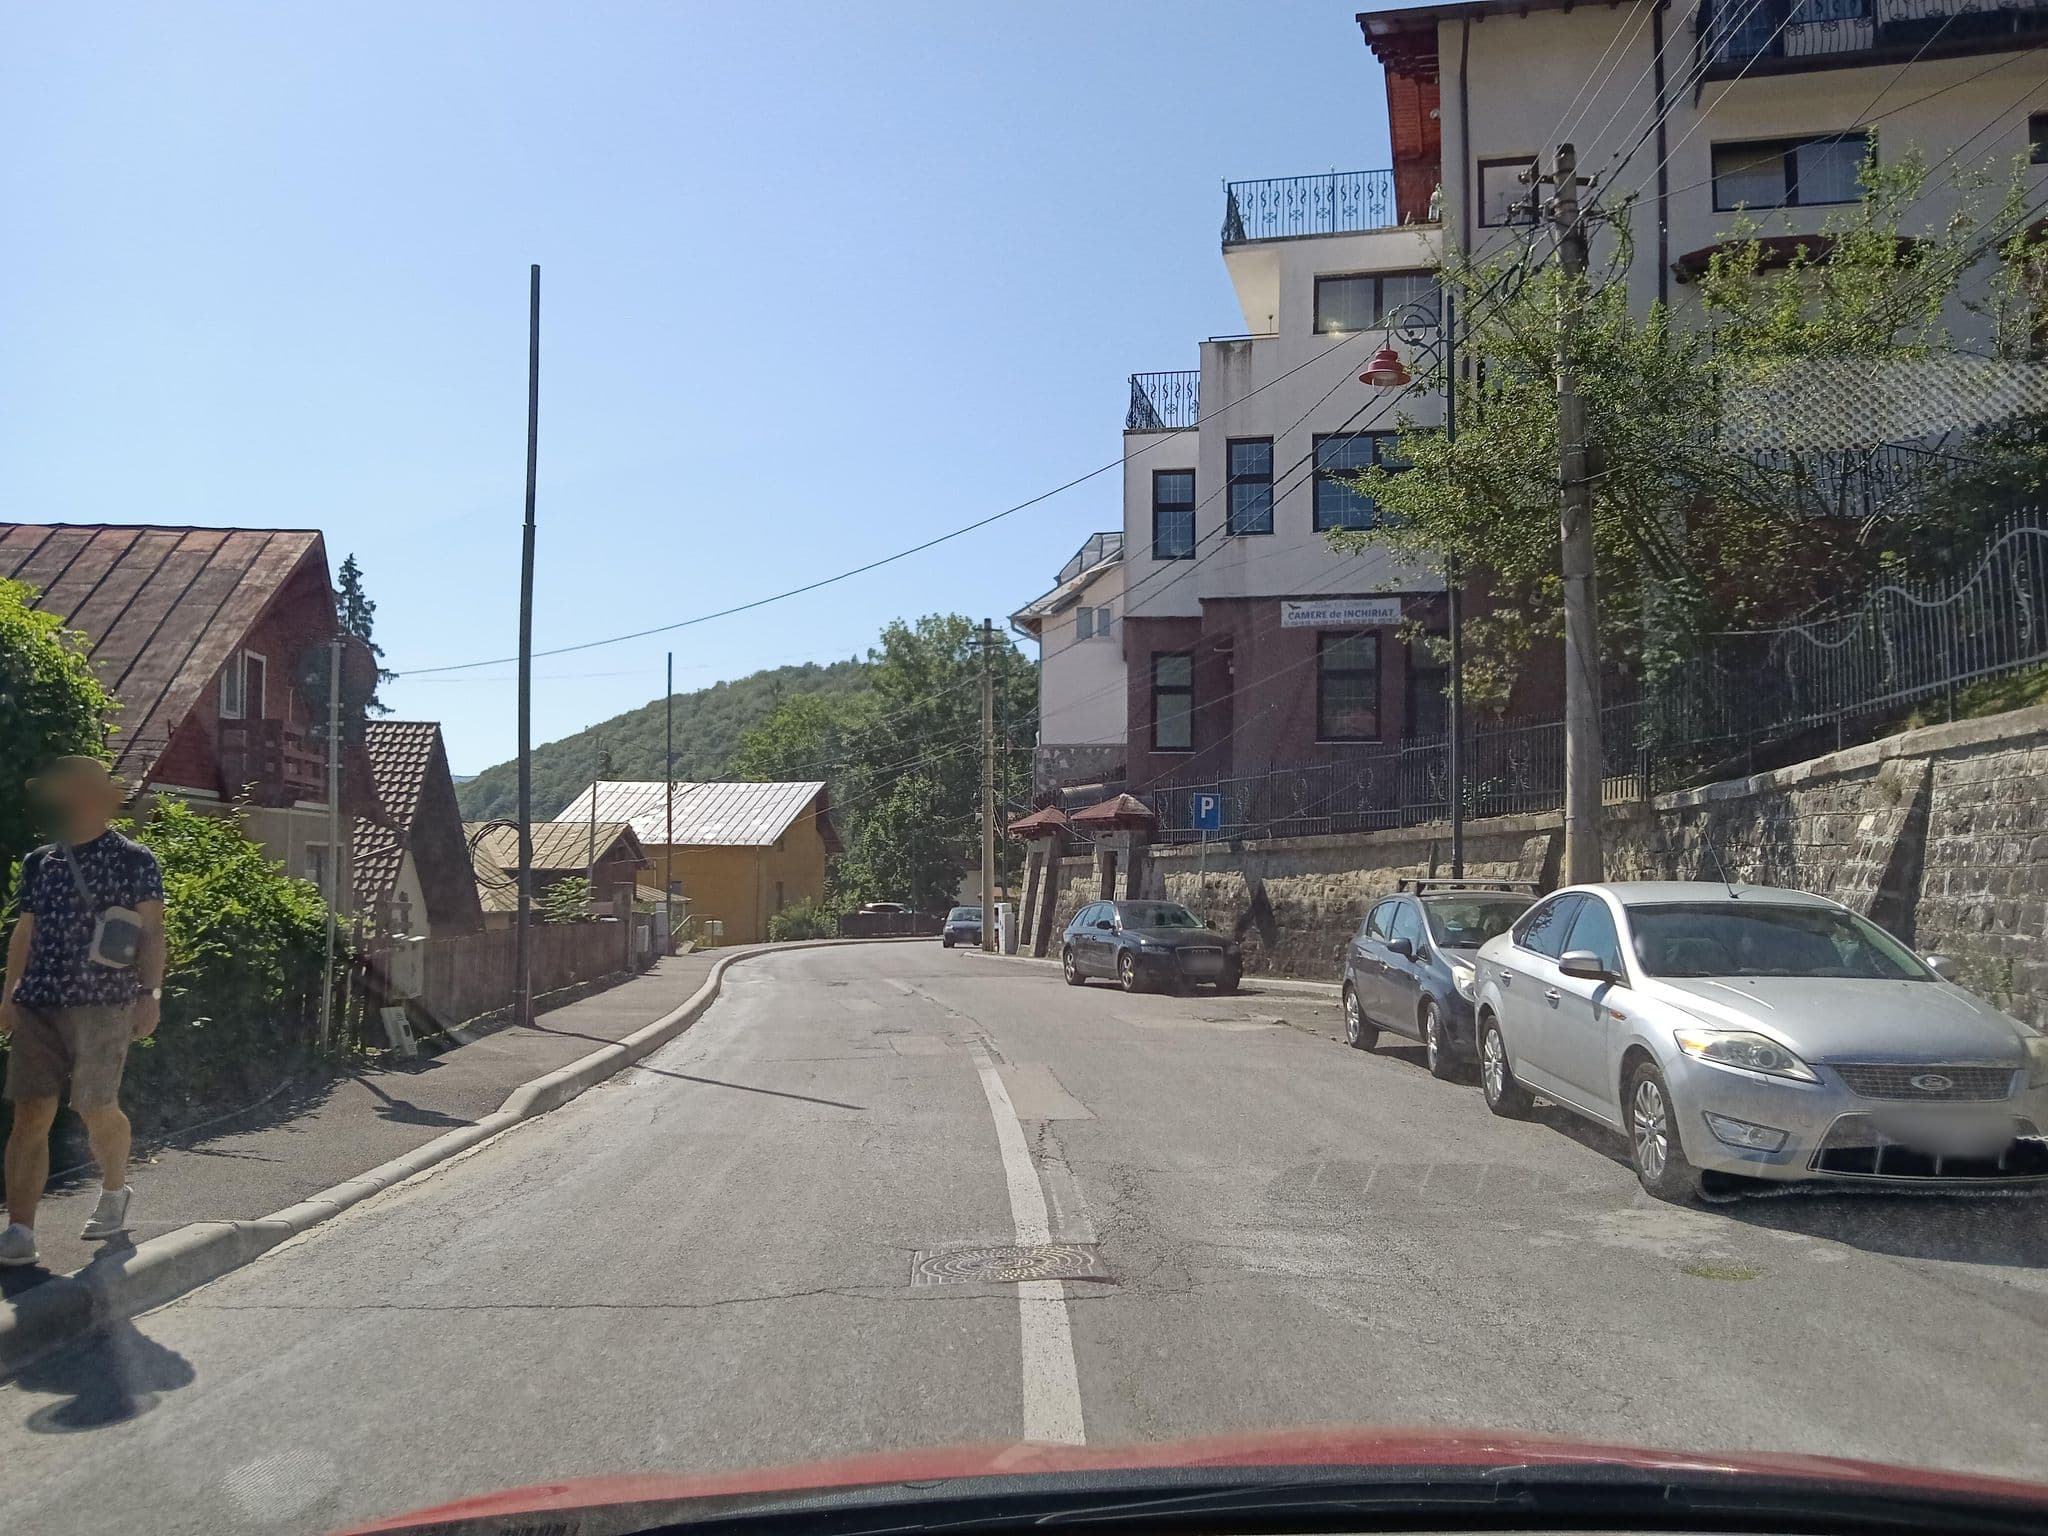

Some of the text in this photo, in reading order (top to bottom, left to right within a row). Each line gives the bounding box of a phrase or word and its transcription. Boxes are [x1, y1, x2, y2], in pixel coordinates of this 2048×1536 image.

[1288, 608, 1394, 620] CAMERE de INCHIRIAT
[1201, 796, 1214, 819] P
